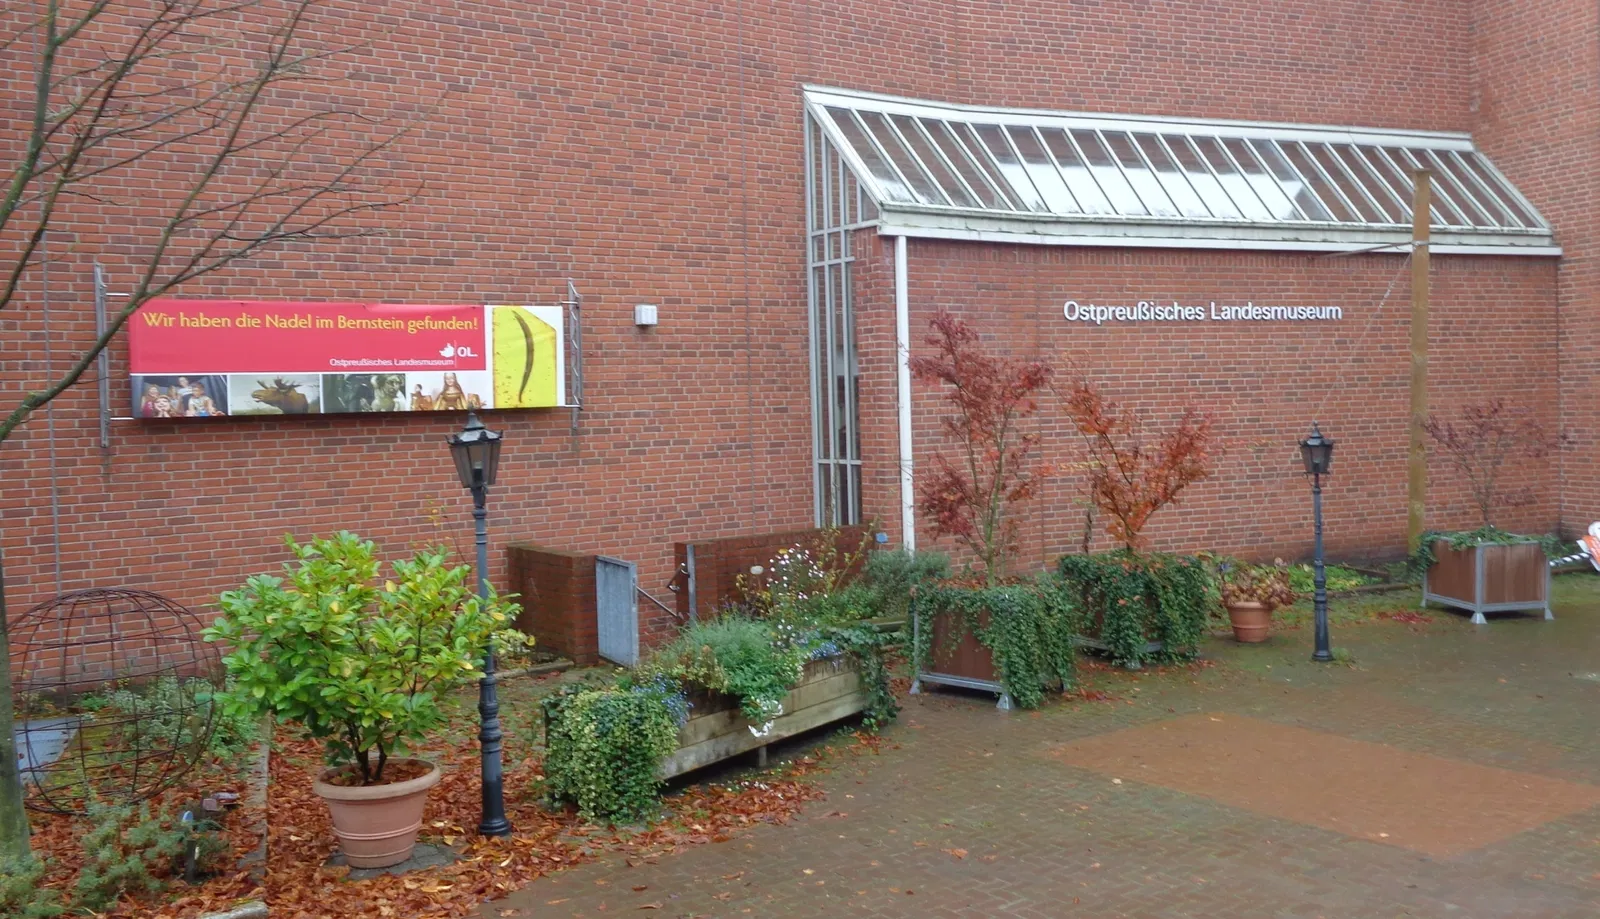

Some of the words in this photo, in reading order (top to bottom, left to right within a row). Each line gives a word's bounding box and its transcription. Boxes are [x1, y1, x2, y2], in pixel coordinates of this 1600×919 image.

[142, 312, 176, 327] Wir
[179, 312, 232, 328] haben
[235, 313, 261, 328] die
[265, 313, 312, 329] Nadel
[315, 315, 334, 328] im
[337, 315, 404, 330] Bernstein
[407, 316, 479, 334] gefunden!
[1063, 300, 1205, 325] Ostpreußisches
[1210, 301, 1343, 321] Landesmuseum
[329, 358, 393, 367] Ostpreußisches
[394, 358, 454, 366] Landesmuseum
